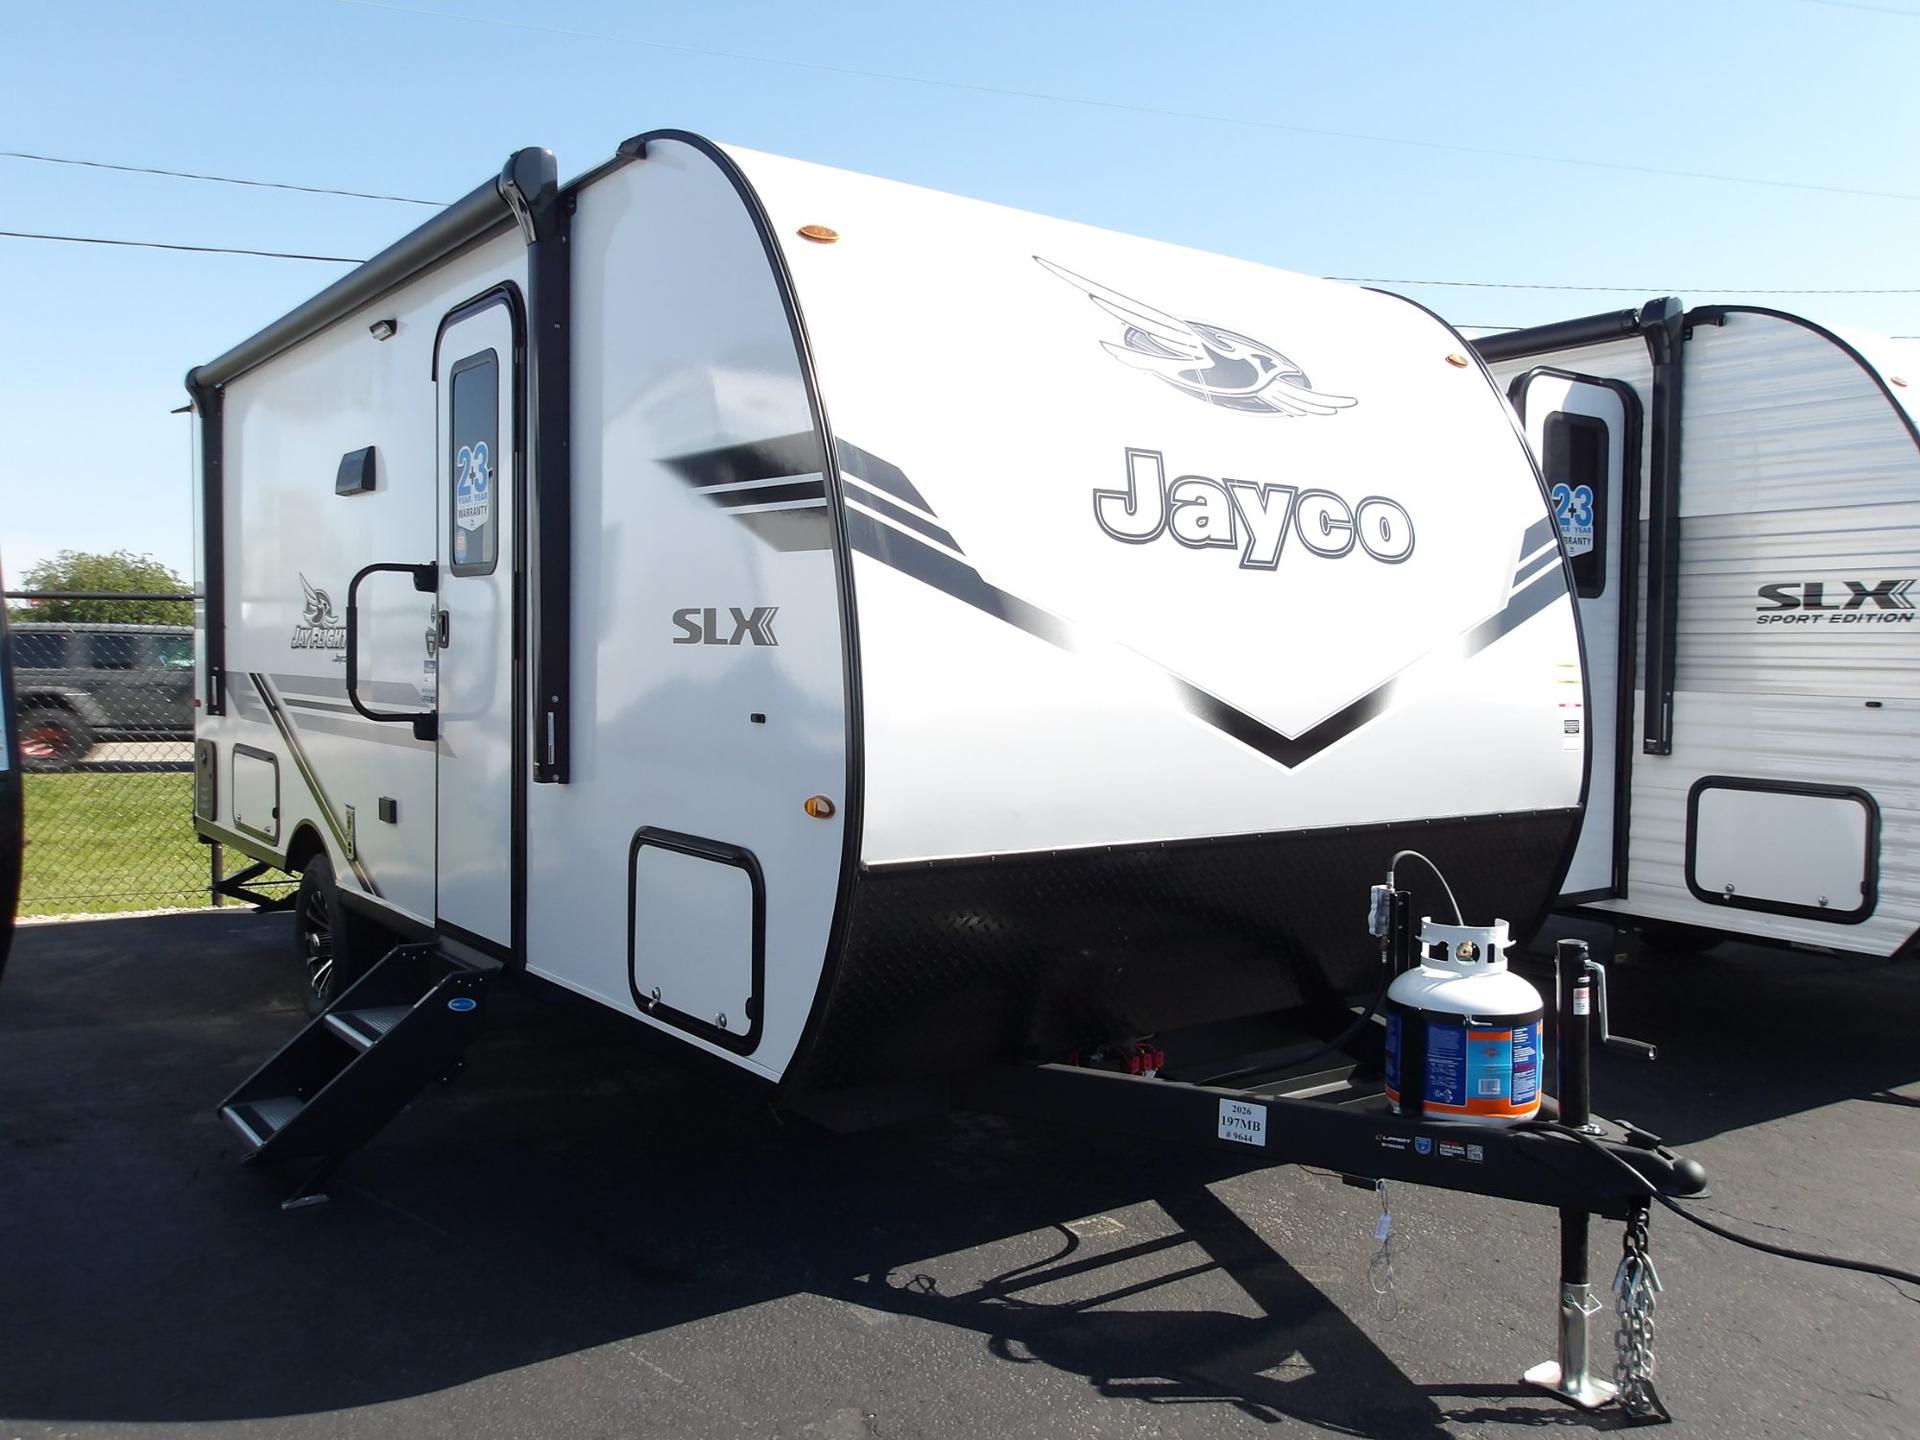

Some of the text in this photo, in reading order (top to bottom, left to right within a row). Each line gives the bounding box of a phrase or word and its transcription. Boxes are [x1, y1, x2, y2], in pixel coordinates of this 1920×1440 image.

[458, 505, 488, 519] WARRANTY
[1093, 447, 1415, 572] Jayco
[1756, 579, 1917, 612] SLX
[672, 606, 779, 646] SLX
[1756, 612, 1915, 625] SPORT EDITION
[291, 624, 313, 649] JAY
[1232, 1104, 1252, 1115] 2026
[1222, 1115, 1261, 1132] 197MB
[1233, 1132, 1253, 1142] 9644
